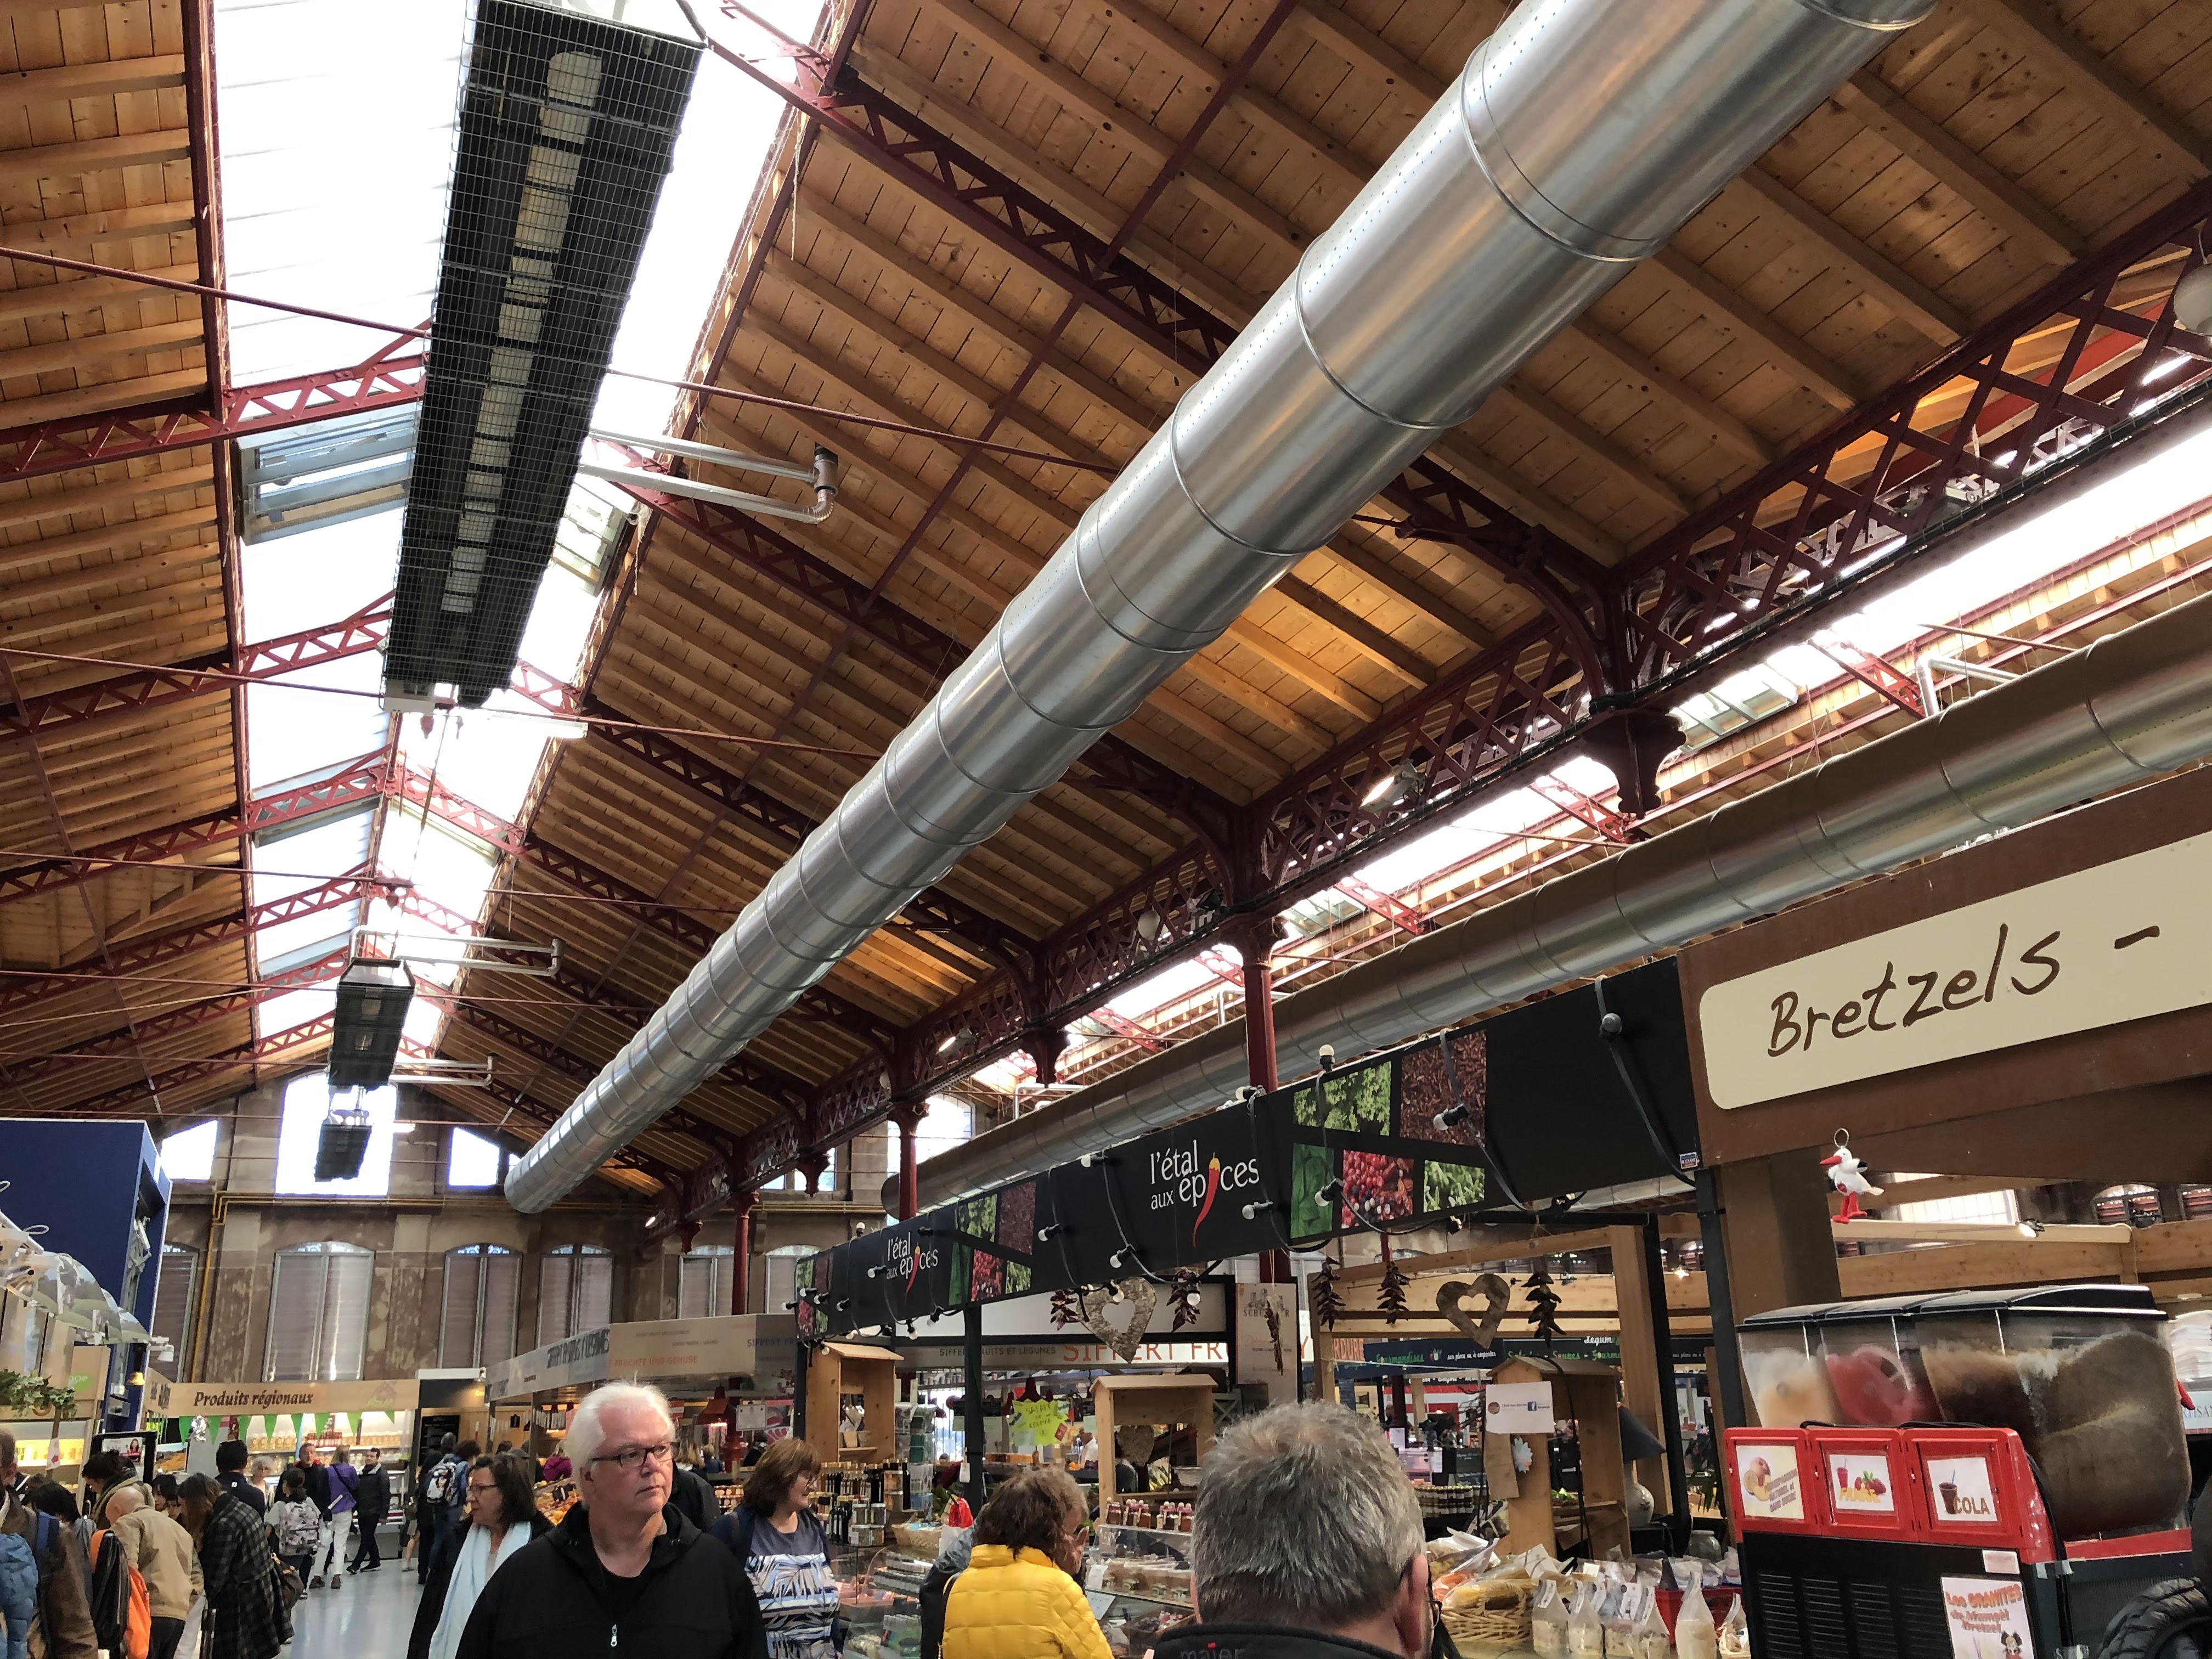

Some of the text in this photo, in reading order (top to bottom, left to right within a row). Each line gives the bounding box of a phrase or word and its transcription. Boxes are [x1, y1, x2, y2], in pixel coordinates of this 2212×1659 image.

[1768, 923, 2061, 1058] Bretzels
[1151, 1190, 1174, 1210] aux
[886, 1266, 898, 1279] aux
[981, 1347, 1003, 1356] RUITS
[1007, 1347, 1016, 1355] ET
[194, 1390, 314, 1409] Produits régionaux
[1953, 1497, 1991, 1515] COLA
